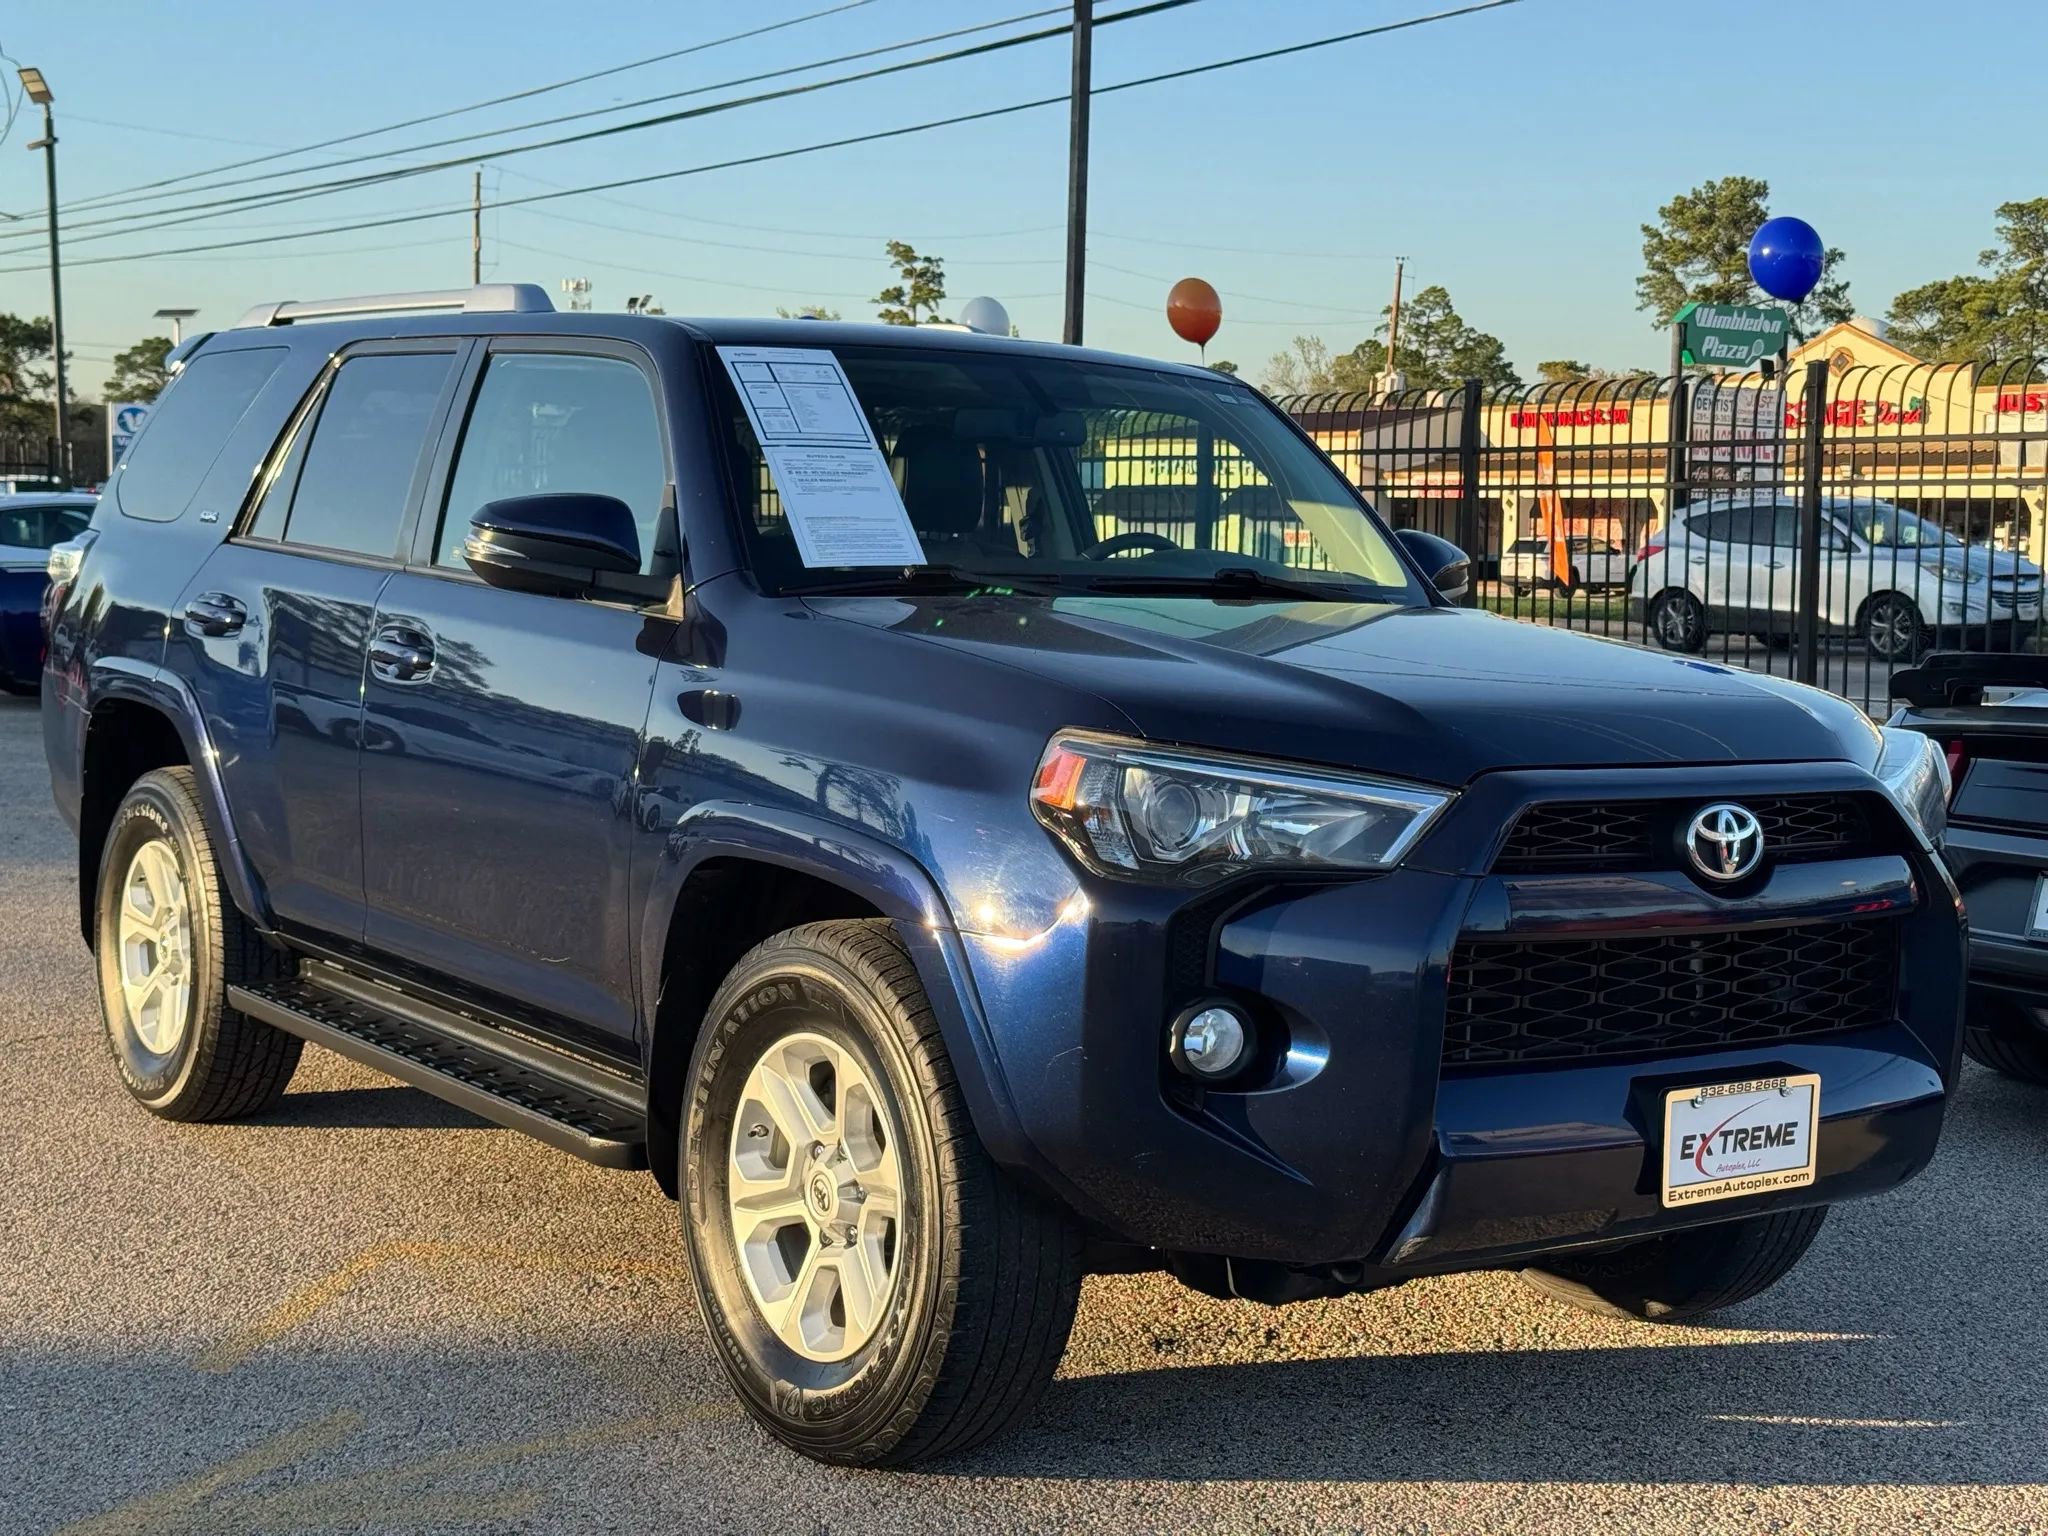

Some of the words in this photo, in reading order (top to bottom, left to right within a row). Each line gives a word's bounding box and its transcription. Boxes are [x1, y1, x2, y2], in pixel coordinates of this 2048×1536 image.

[1695, 306, 1782, 334] Wimbledon
[1701, 335, 1749, 360] Plaza
[1680, 1121, 1798, 1160] EXTREME
[1747, 1158, 1762, 1169] LLC
[1668, 1172, 1809, 1202] ExtremeAutoplex.com
